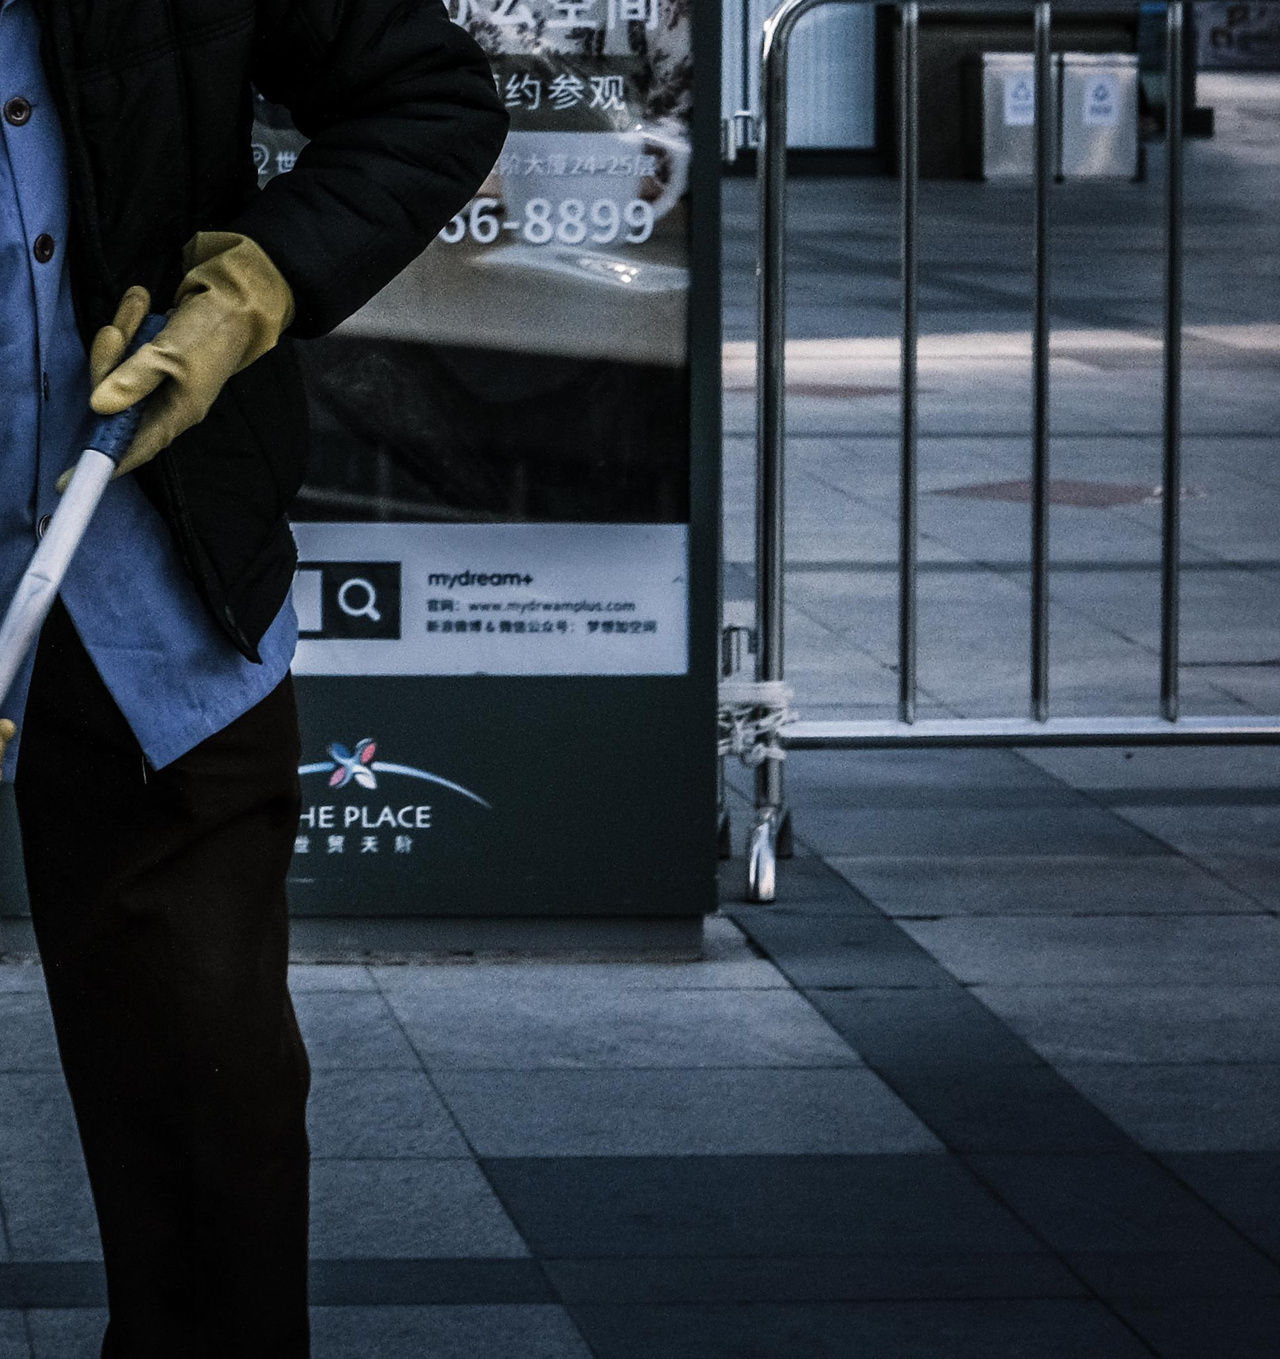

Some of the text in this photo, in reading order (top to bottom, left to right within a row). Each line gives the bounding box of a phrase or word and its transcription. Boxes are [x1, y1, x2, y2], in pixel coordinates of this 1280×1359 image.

[493, 73, 626, 111] 约参观
[428, 570, 533, 589] mydream+
[344, 805, 432, 828] PLACE
